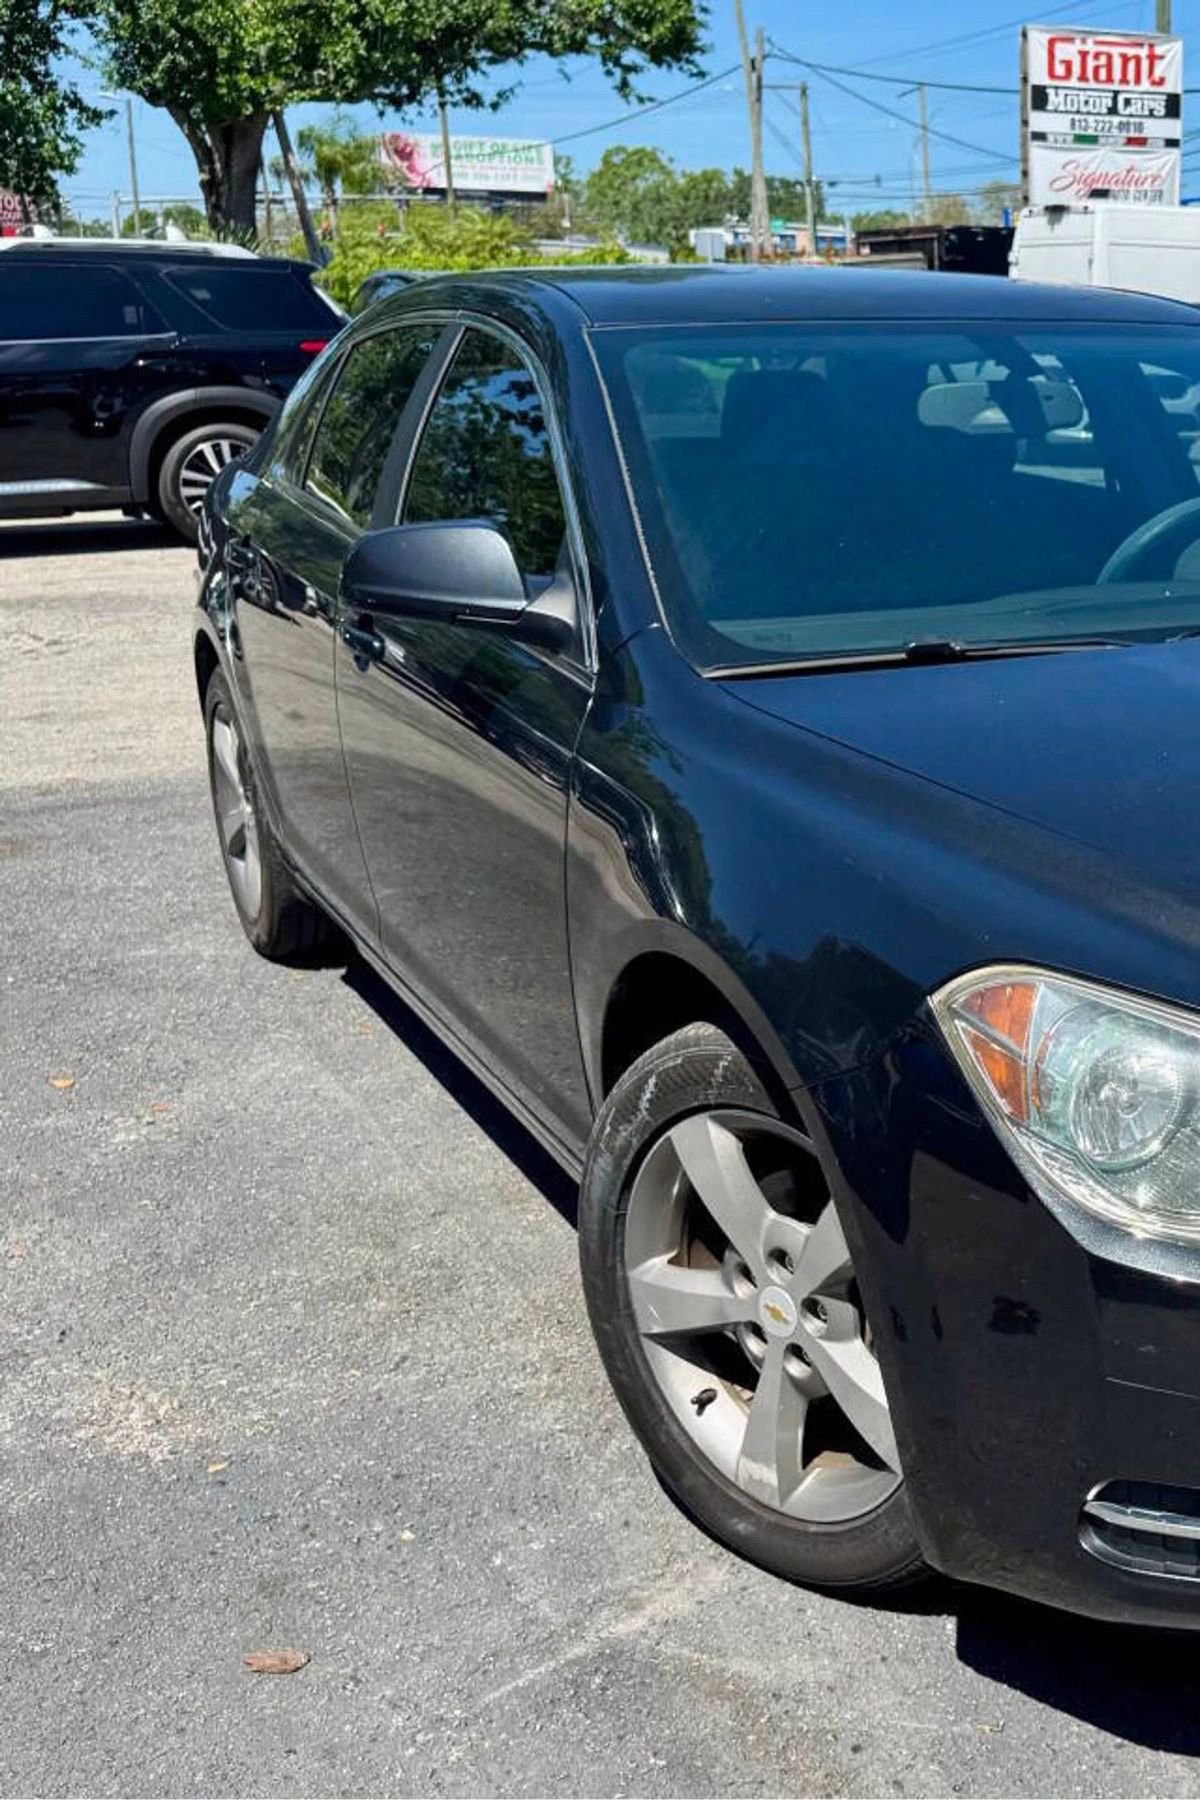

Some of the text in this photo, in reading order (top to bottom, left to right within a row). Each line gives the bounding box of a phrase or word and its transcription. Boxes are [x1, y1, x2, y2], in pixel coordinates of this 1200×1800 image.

[1047, 37, 1166, 87] Giant
[1046, 87, 1167, 117] Motor Cars
[453, 140, 485, 152] GIFT
[490, 141, 508, 152] OF
[1049, 159, 1165, 198] Signature
